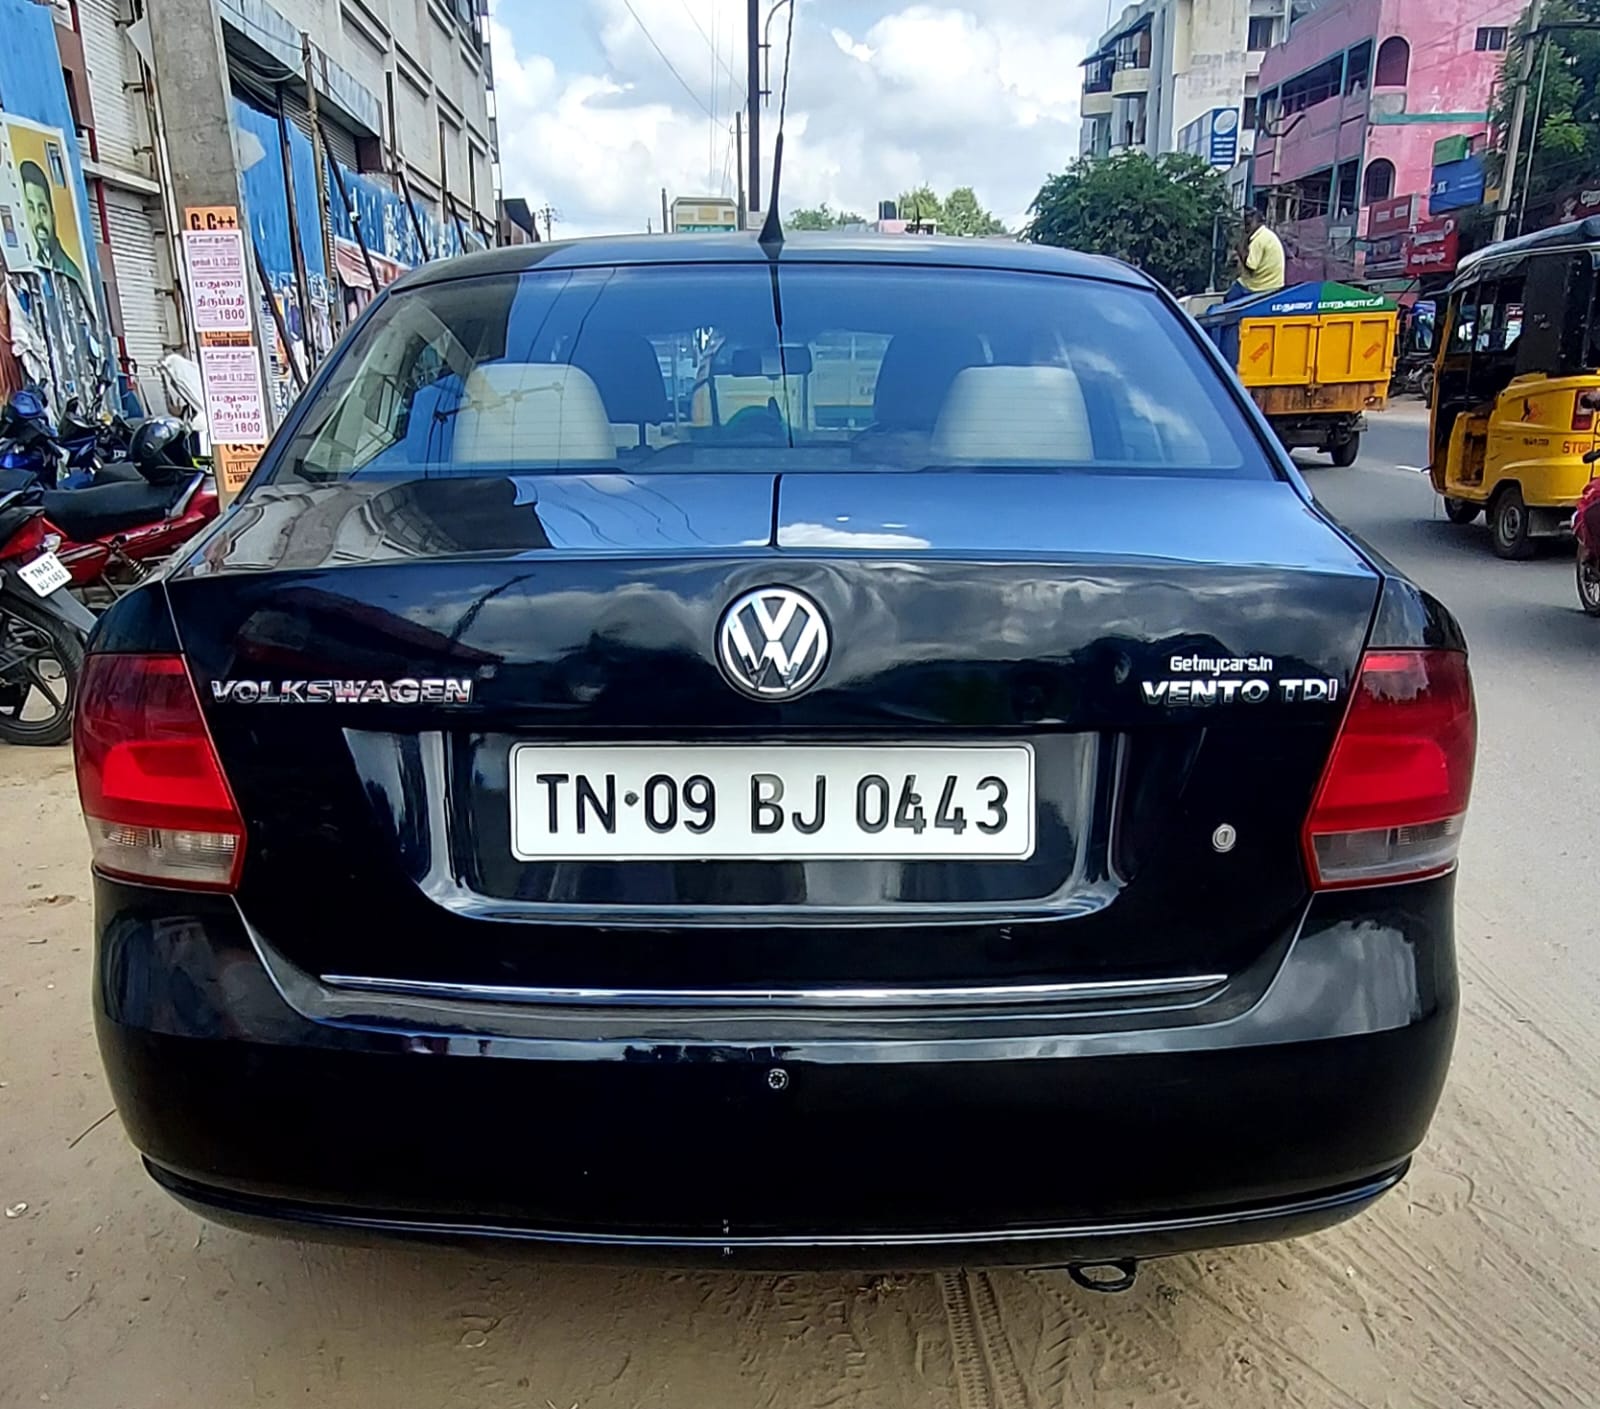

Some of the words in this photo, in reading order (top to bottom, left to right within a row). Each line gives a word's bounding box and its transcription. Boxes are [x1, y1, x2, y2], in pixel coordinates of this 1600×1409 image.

[218, 309, 245, 320] 1800
[234, 422, 260, 433] 1800
[210, 679, 473, 704] VOLKSWAGEN
[1141, 679, 1270, 703] VENTO
[1278, 678, 1339, 702] TDI
[536, 773, 616, 835] TN
[644, 773, 716, 835] 09
[751, 773, 827, 835] BJ
[855, 773, 1009, 836] 0443
